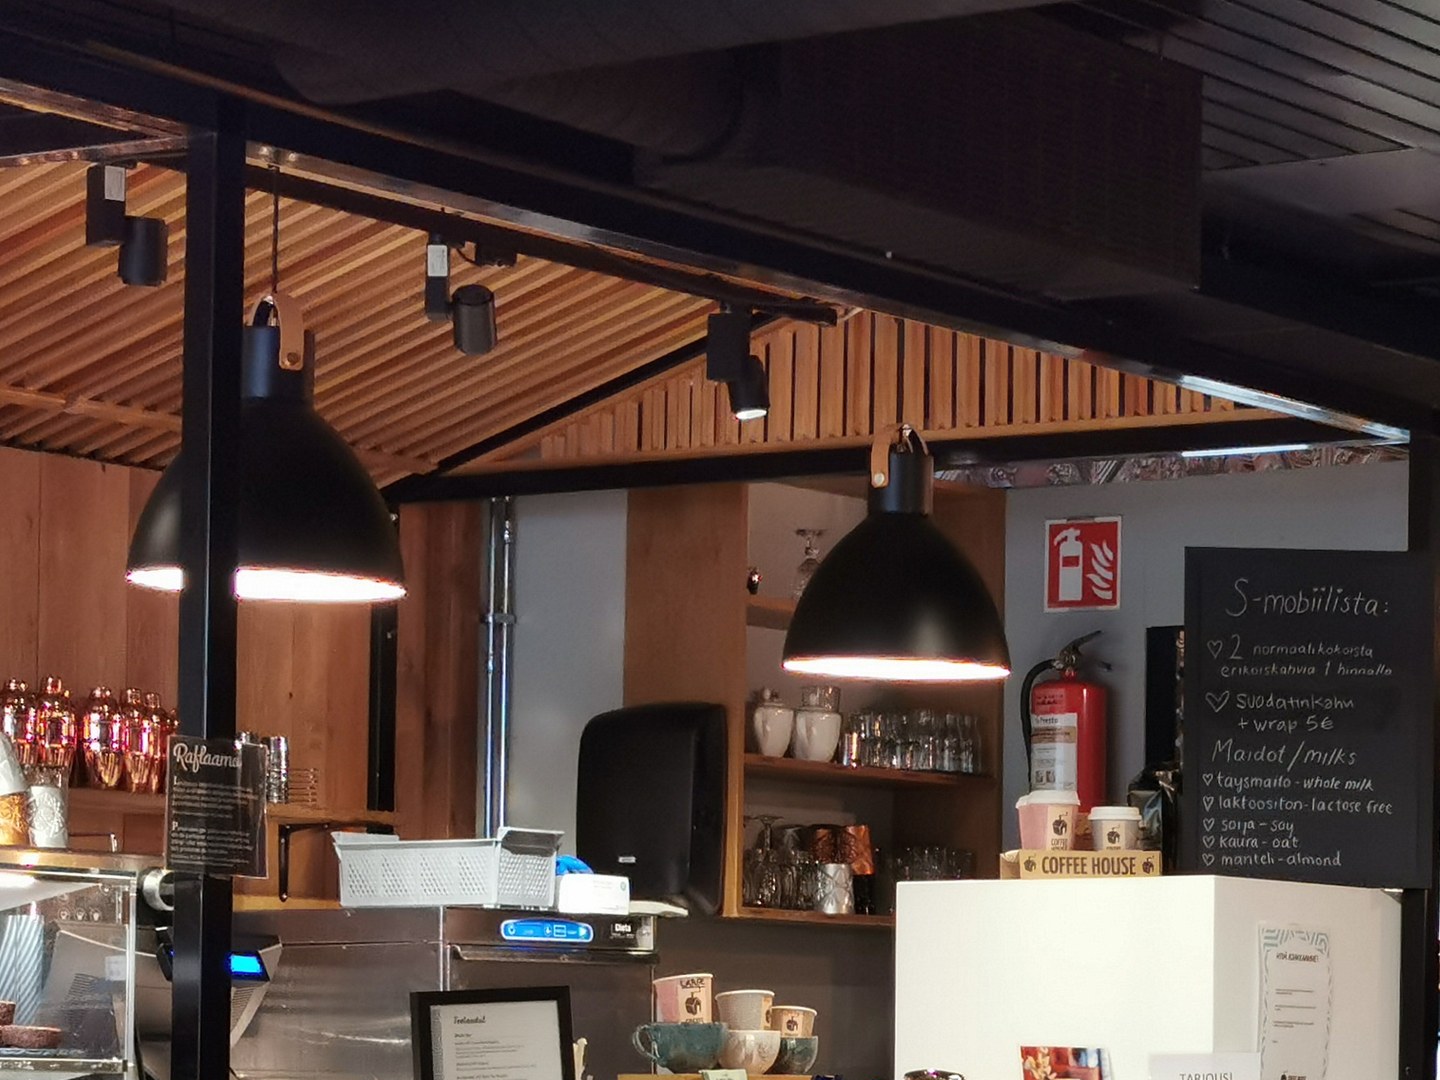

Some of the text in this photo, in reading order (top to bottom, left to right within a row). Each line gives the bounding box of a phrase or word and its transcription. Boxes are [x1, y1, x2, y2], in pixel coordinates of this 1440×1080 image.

[1225, 577, 1389, 617] S-mobiilista:
[1229, 634, 1243, 660] 2
[1253, 719, 1298, 734] wrap
[1365, 800, 1393, 815] free
[1042, 856, 1137, 876] COFFEE HOUSE
